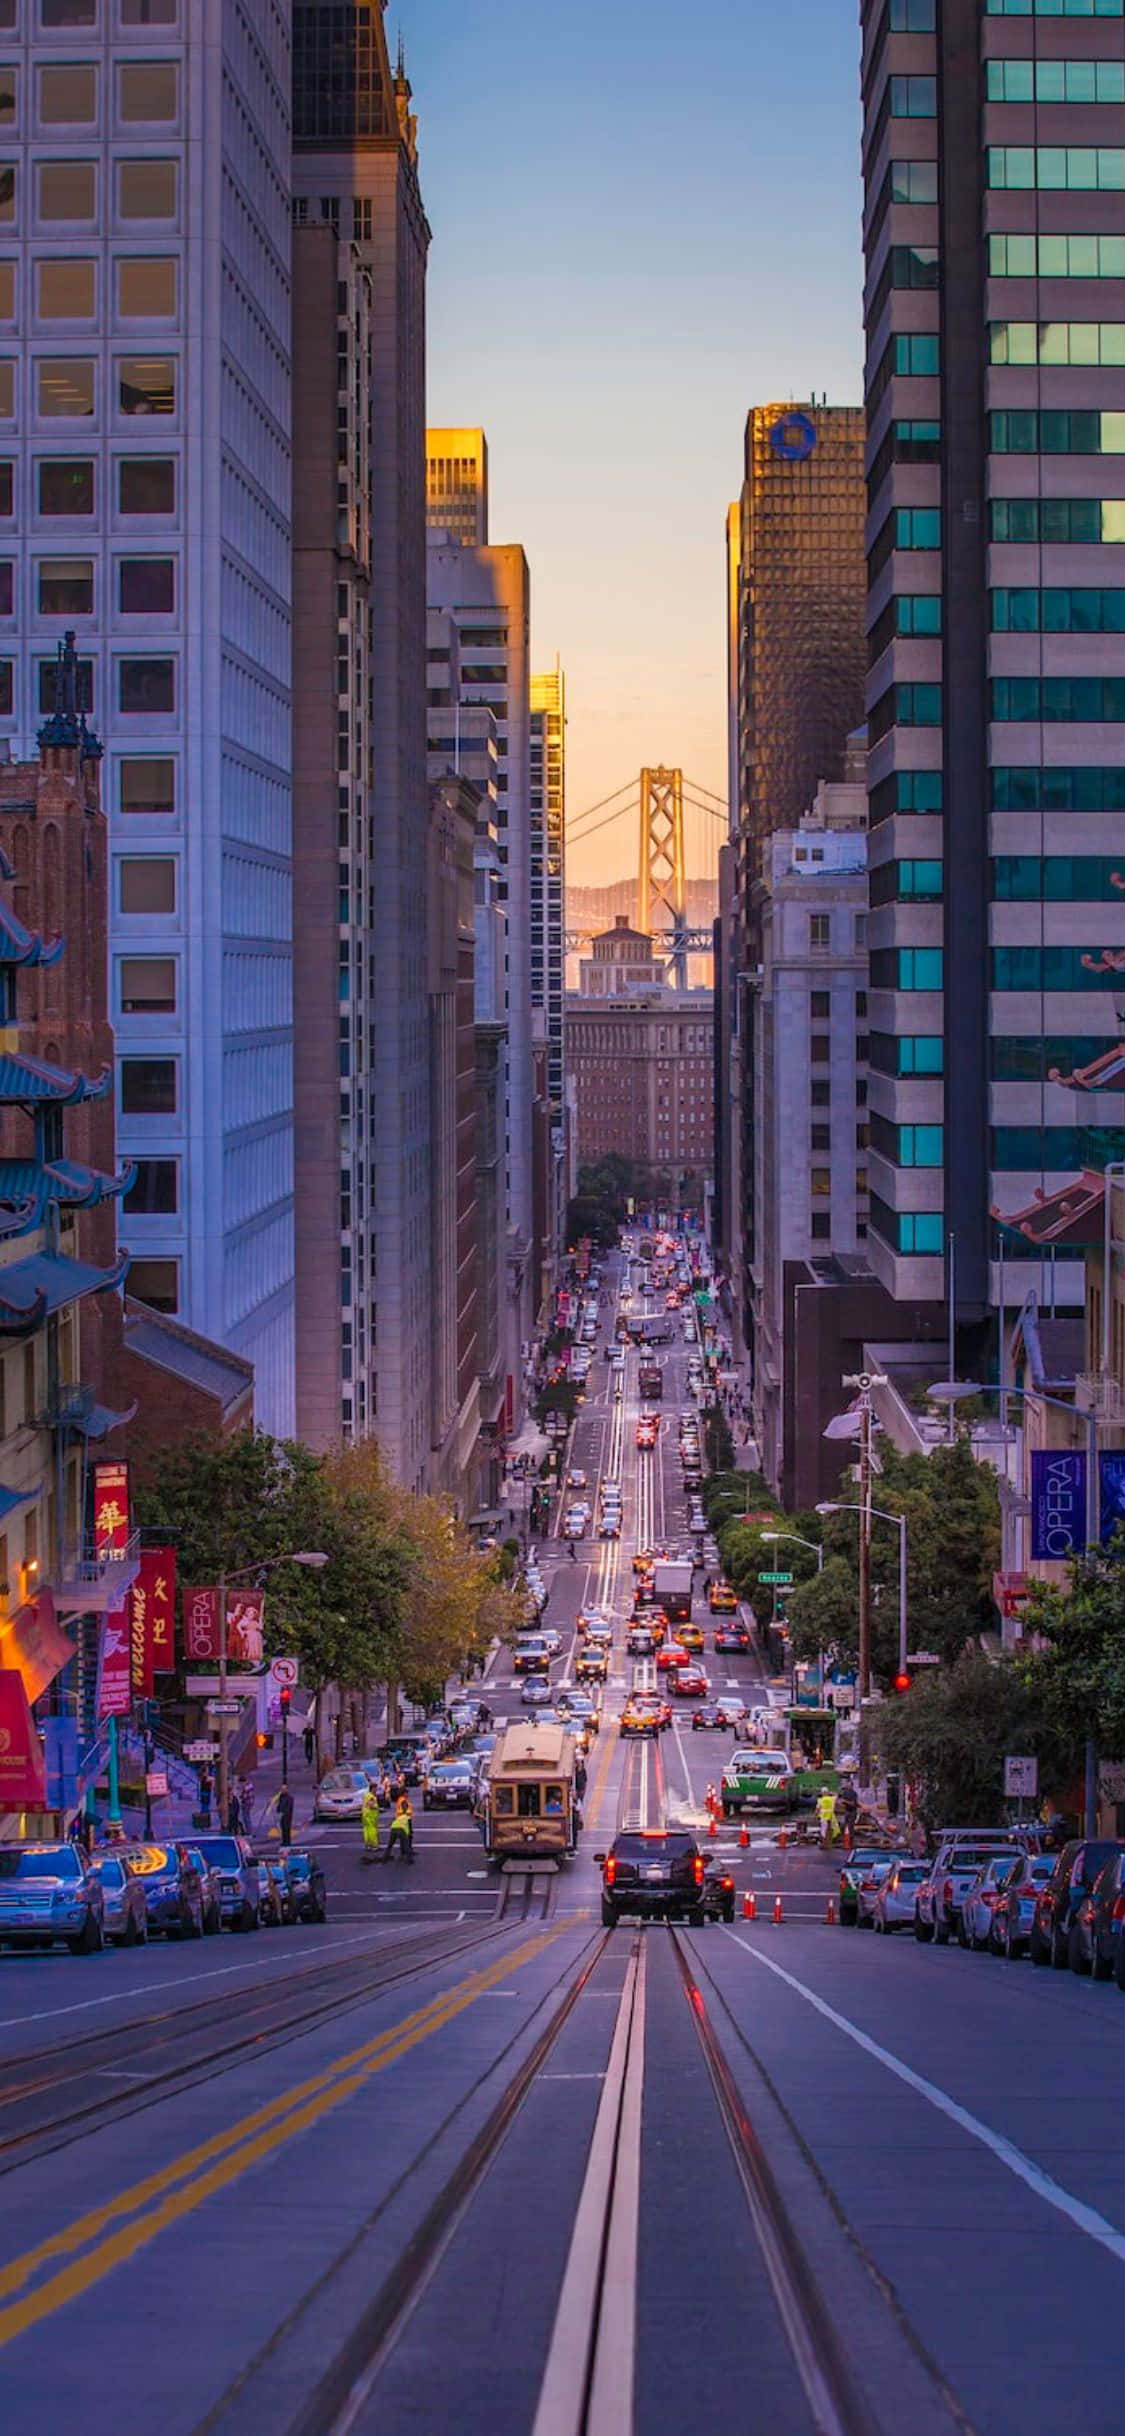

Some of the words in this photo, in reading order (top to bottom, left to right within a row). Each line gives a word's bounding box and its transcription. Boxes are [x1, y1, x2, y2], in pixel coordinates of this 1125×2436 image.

[1046, 1456, 1072, 1555] OPERA
[132, 1586, 146, 1687] welcome
[193, 1591, 212, 1656] OPERA
